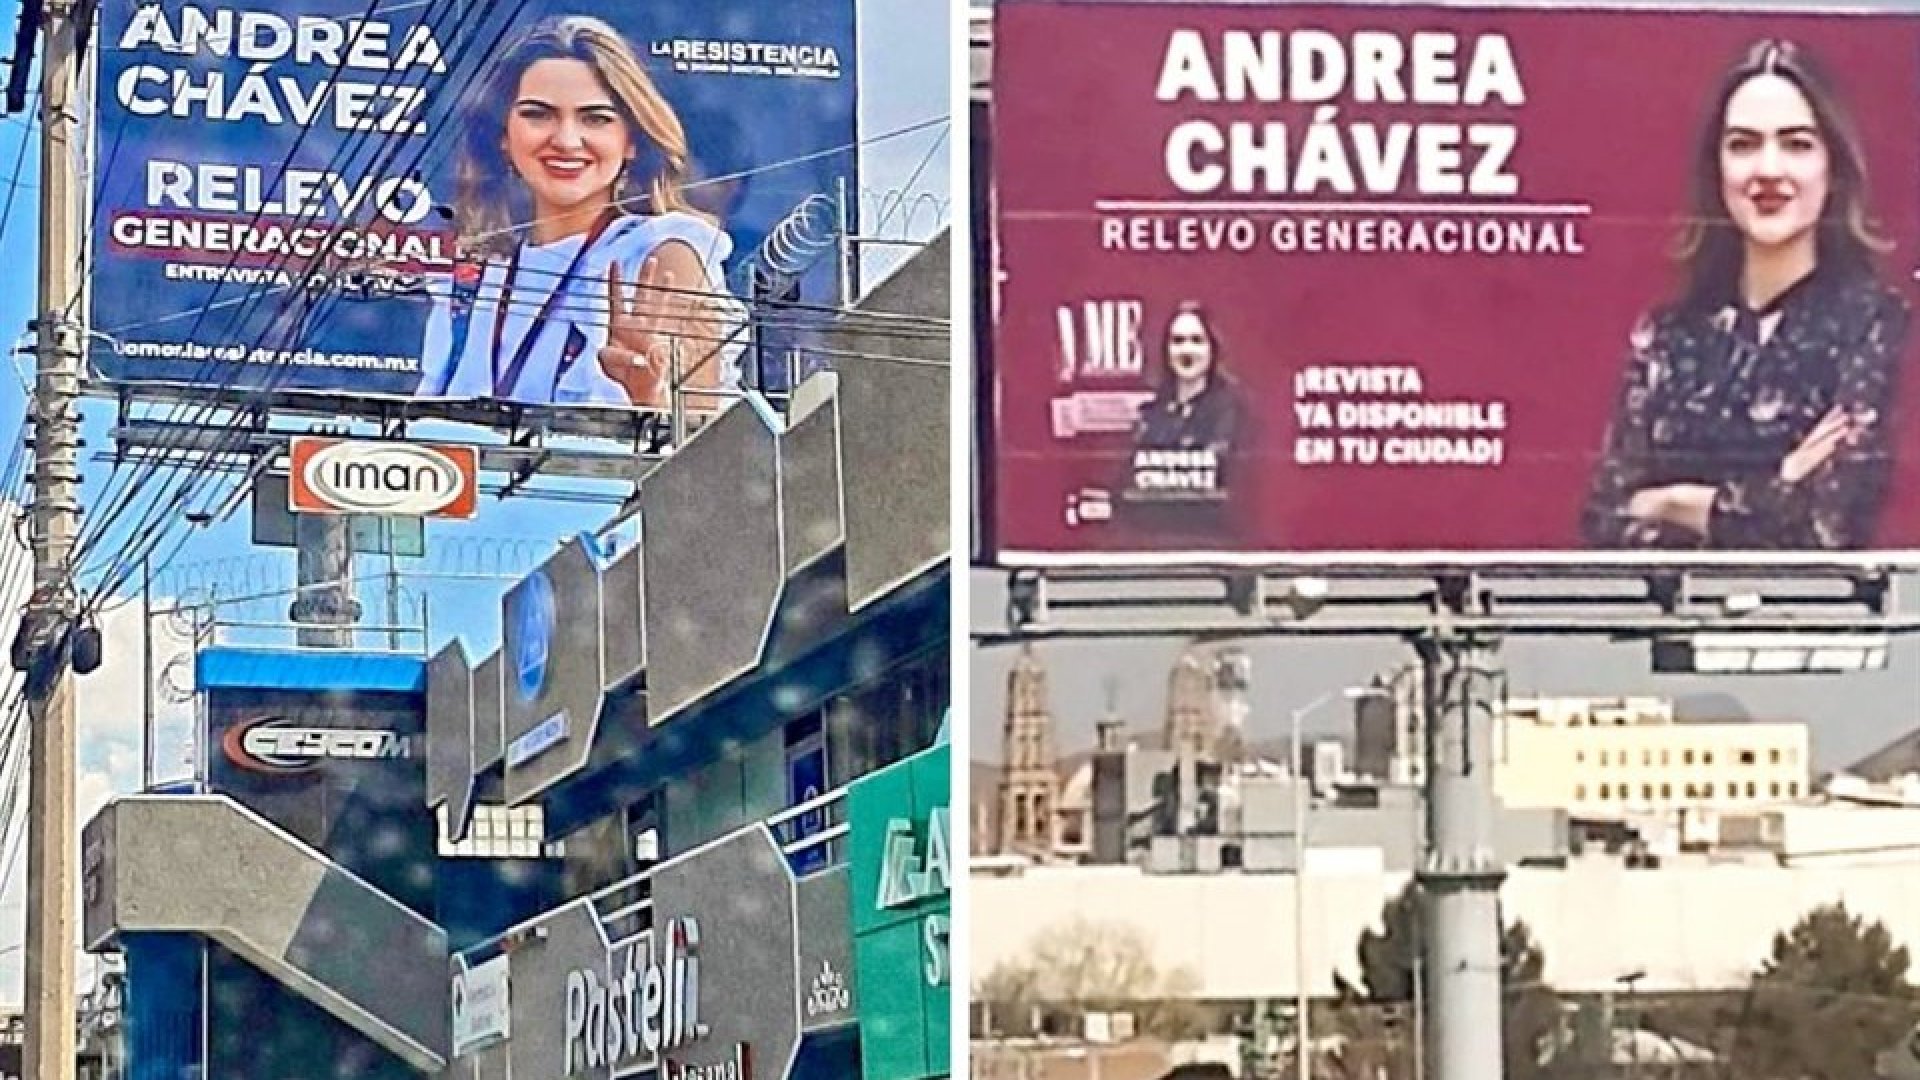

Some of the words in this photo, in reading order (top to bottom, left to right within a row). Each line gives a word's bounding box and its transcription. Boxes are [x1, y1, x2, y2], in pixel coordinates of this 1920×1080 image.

[118, 3, 447, 73] ANDREA
[651, 41, 671, 55] LA
[673, 39, 840, 67] RESISTENCIA
[1155, 29, 1526, 104] ANDREA
[117, 61, 428, 134] CHÁVEZ
[1164, 105, 1519, 195] CHÁVEZ
[147, 159, 431, 224] RELEVO
[112, 216, 453, 266] GENERACIONAL
[1102, 217, 1255, 250] RELEVO
[1271, 219, 1584, 253] GENERACIONAL
[1295, 366, 1423, 398] ¡REVISTA
[1294, 402, 1333, 429] YA
[1337, 402, 1507, 430] DISPONIBLE
[1295, 437, 1335, 464] EN
[1339, 437, 1379, 464] TU
[1383, 437, 1505, 466] CIUDAD!
